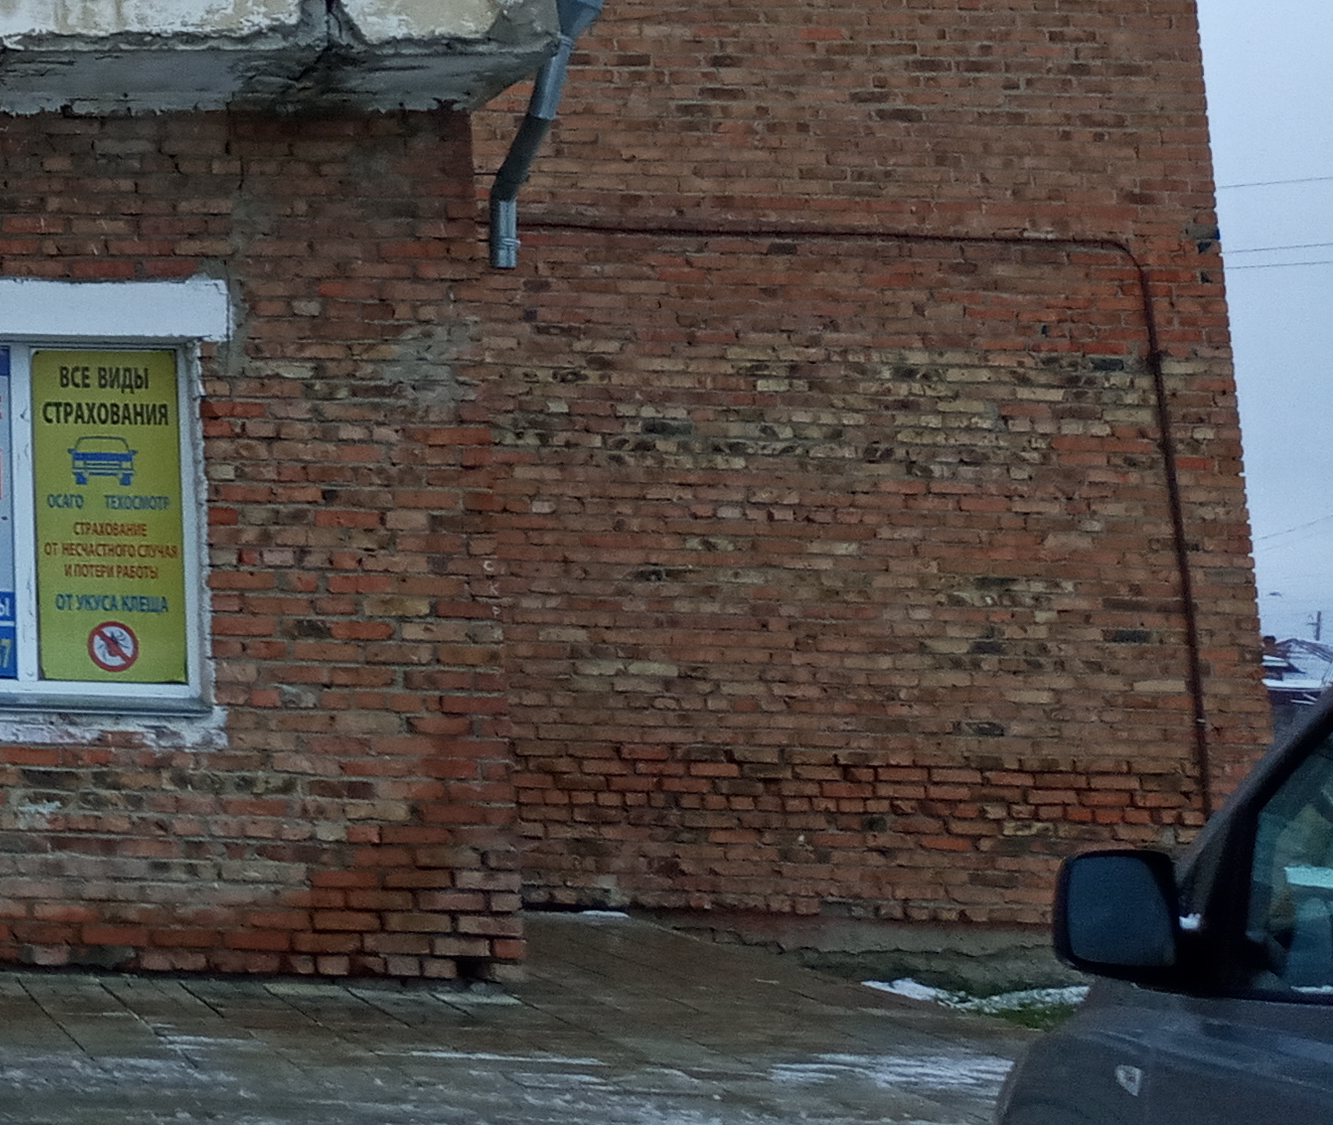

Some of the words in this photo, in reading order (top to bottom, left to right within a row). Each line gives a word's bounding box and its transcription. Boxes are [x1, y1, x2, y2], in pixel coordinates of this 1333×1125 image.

[59, 365, 91, 389] ВСЕ
[97, 366, 150, 394] ВИДЫ
[42, 401, 169, 426] СТРАХОВАНИЯ
[46, 493, 84, 510] ОСАГО
[72, 521, 148, 537] СТРАХОВАНИЕ
[43, 542, 59, 556] ОТ
[61, 542, 136, 558] НЕСЧАСТНОГО
[137, 544, 180, 559] СЛУЧАЯ
[73, 563, 114, 578] ПОТЕРИ
[116, 565, 159, 579] РАБОТЫ
[55, 593, 73, 611] ОТ
[76, 594, 118, 612] УКУСА
[121, 595, 169, 613] КЛЕЩА
